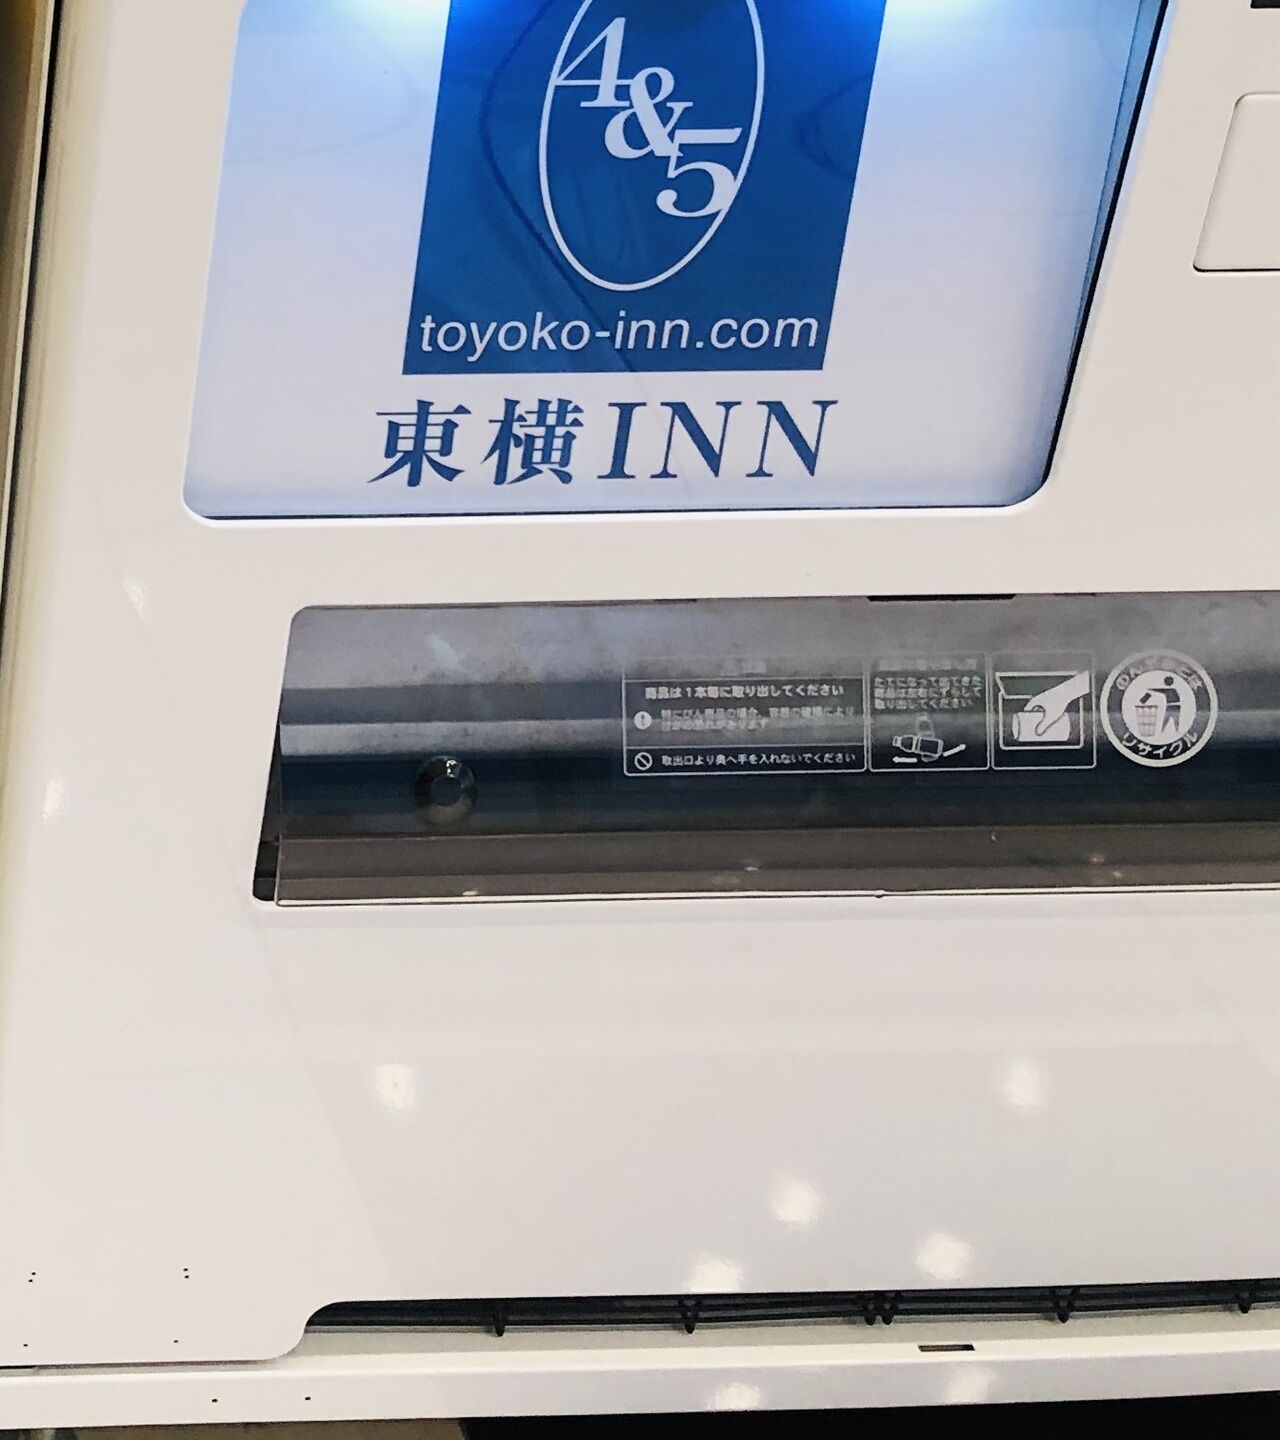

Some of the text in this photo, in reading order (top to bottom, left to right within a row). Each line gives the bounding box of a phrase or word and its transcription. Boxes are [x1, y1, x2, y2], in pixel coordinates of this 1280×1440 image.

[419, 310, 819, 363] toyoko-inn.com
[367, 396, 839, 488] 東横INN
[1121, 731, 1199, 759] リサイクル
